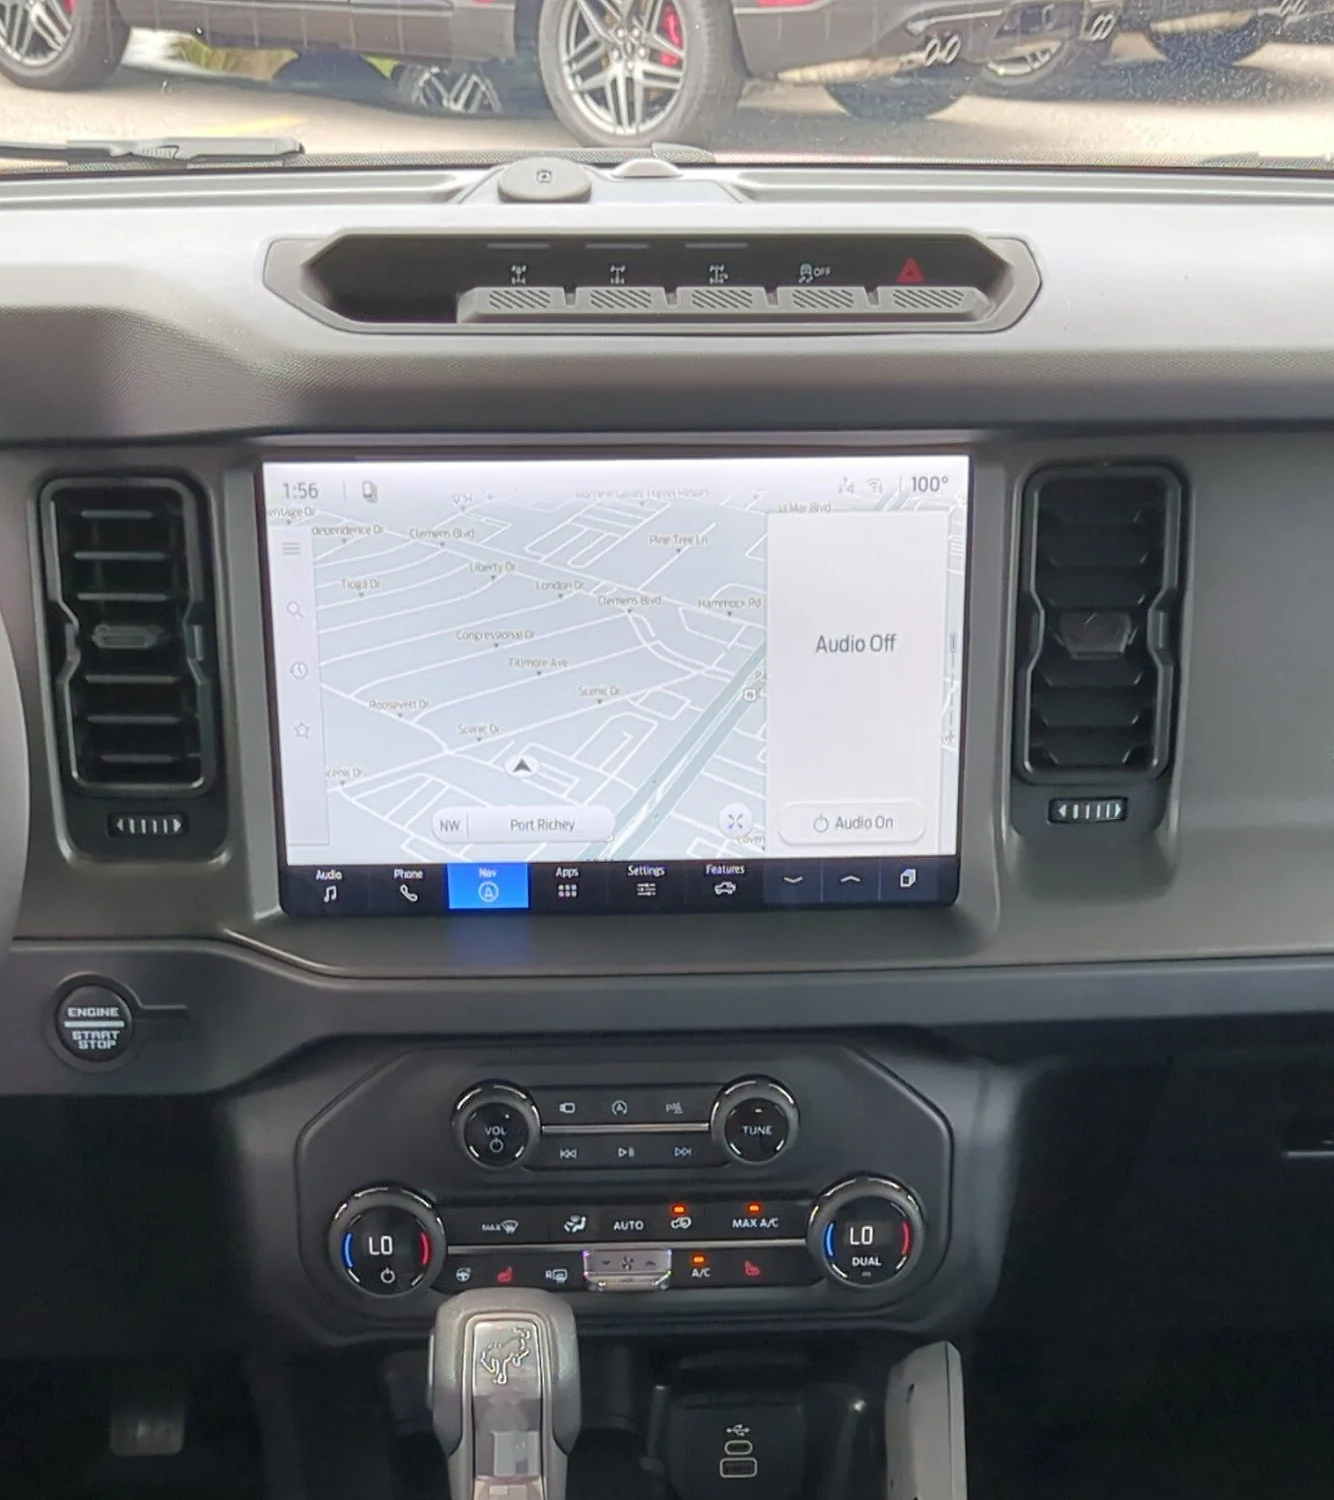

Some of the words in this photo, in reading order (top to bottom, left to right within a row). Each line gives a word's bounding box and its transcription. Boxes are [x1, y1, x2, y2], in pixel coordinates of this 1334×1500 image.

[813, 267, 830, 277] OFF
[911, 476, 948, 492] 100°
[283, 482, 318, 499] 1:56
[312, 525, 371, 537] dependence
[453, 529, 474, 539] Blvd
[650, 535, 671, 545] Pine
[673, 535, 693, 545] Tree
[696, 535, 708, 545] Ln
[470, 562, 502, 573] Liberty
[505, 562, 516, 572] Dr
[369, 579, 380, 588] Dr
[536, 580, 572, 590] London
[574, 580, 584, 590] Dr
[597, 596, 639, 606] Clemens
[641, 596, 662, 606] Blvd
[748, 598, 761, 608] Rd
[456, 630, 522, 641] Congressional
[524, 630, 535, 640] Dr
[816, 635, 866, 653] Audio
[870, 634, 897, 653] Off
[549, 658, 568, 668] Ave
[578, 686, 607, 696] Scenic
[610, 686, 620, 696] Dr
[418, 700, 429, 710] Dr
[325, 769, 350, 778] cenic
[440, 820, 460, 831] NW
[510, 819, 535, 832] Port
[538, 818, 575, 833] Richey
[836, 816, 872, 829] Audio
[875, 816, 893, 829] On
[393, 868, 423, 879] Phone
[479, 868, 497, 878] Nav
[555, 867, 579, 879] Apps
[627, 864, 665, 877] Settings
[705, 863, 745, 875] Features
[316, 869, 342, 880] Audio
[68, 1007, 120, 1017] ENGINE
[72, 1030, 120, 1040] START
[78, 1040, 117, 1050] STOP
[485, 1126, 507, 1136] VOL
[742, 1125, 772, 1137] TUNE
[481, 1223, 501, 1232] MAX
[613, 1220, 644, 1231] AUTO
[732, 1218, 757, 1229] MAX
[760, 1217, 779, 1229] A/C
[849, 1225, 874, 1245] LO
[368, 1235, 393, 1256] LO
[852, 1257, 882, 1267] DUAL
[691, 1268, 711, 1278] A/C
